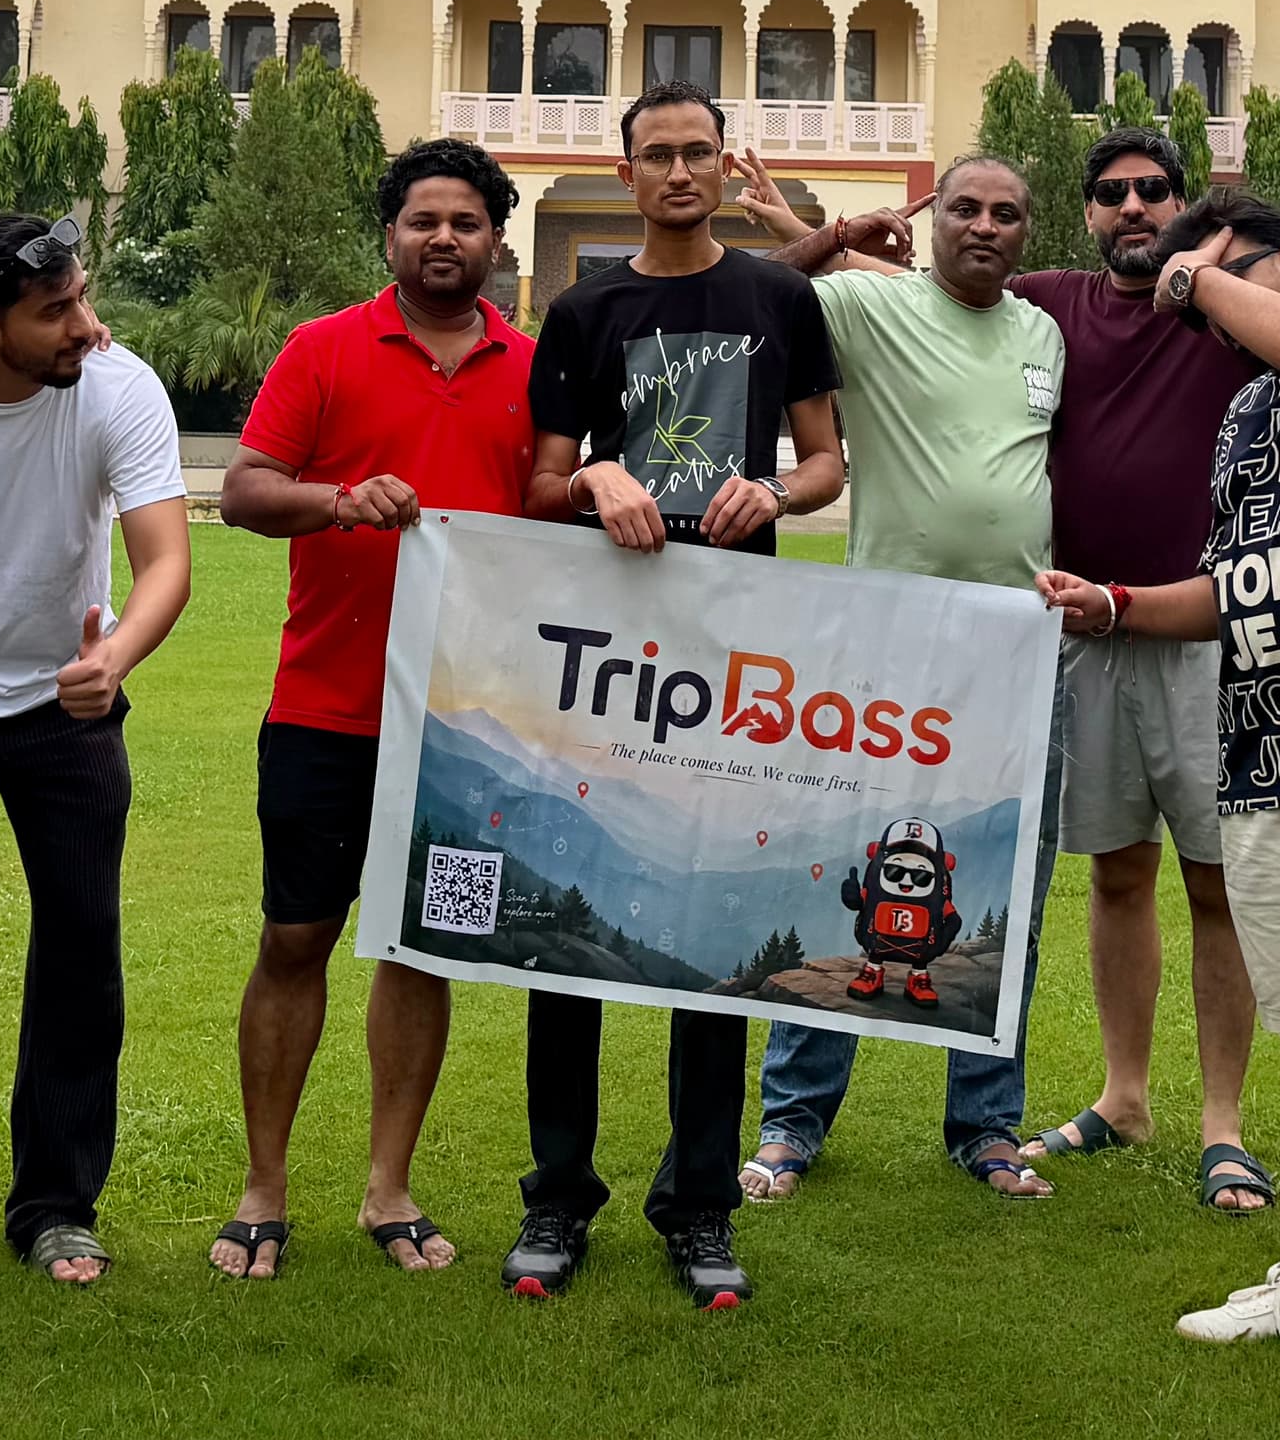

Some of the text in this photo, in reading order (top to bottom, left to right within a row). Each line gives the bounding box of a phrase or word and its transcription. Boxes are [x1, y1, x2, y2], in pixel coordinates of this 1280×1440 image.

[621, 328, 765, 410] embrace
[619, 454, 745, 501] eams
[611, 742, 862, 793] The place comes last. We come first.
